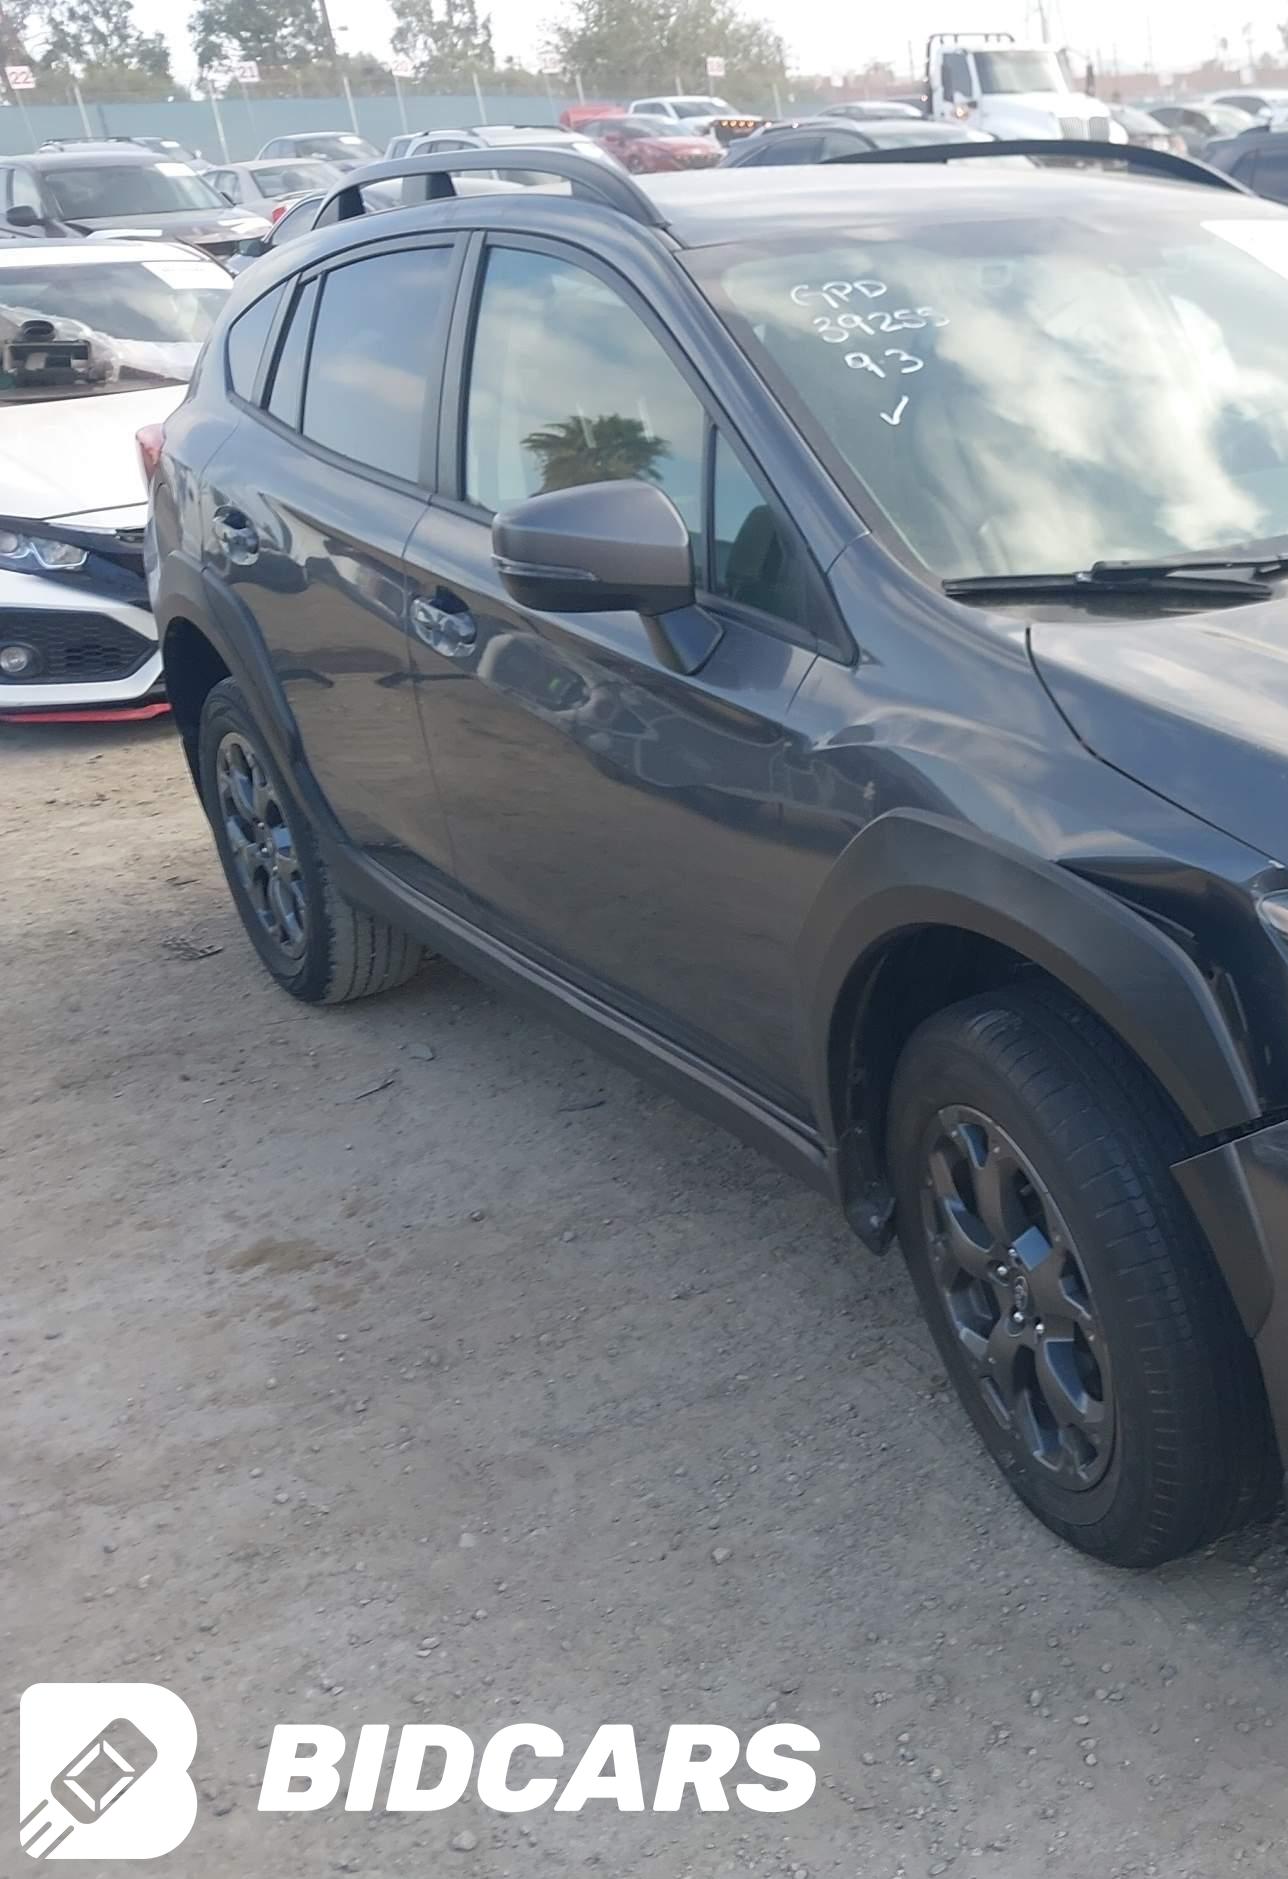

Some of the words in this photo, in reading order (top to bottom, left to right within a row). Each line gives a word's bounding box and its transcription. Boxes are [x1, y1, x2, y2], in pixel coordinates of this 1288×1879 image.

[10, 71, 32, 84] 22
[239, 66, 256, 78] 21
[813, 306, 950, 343] 39255
